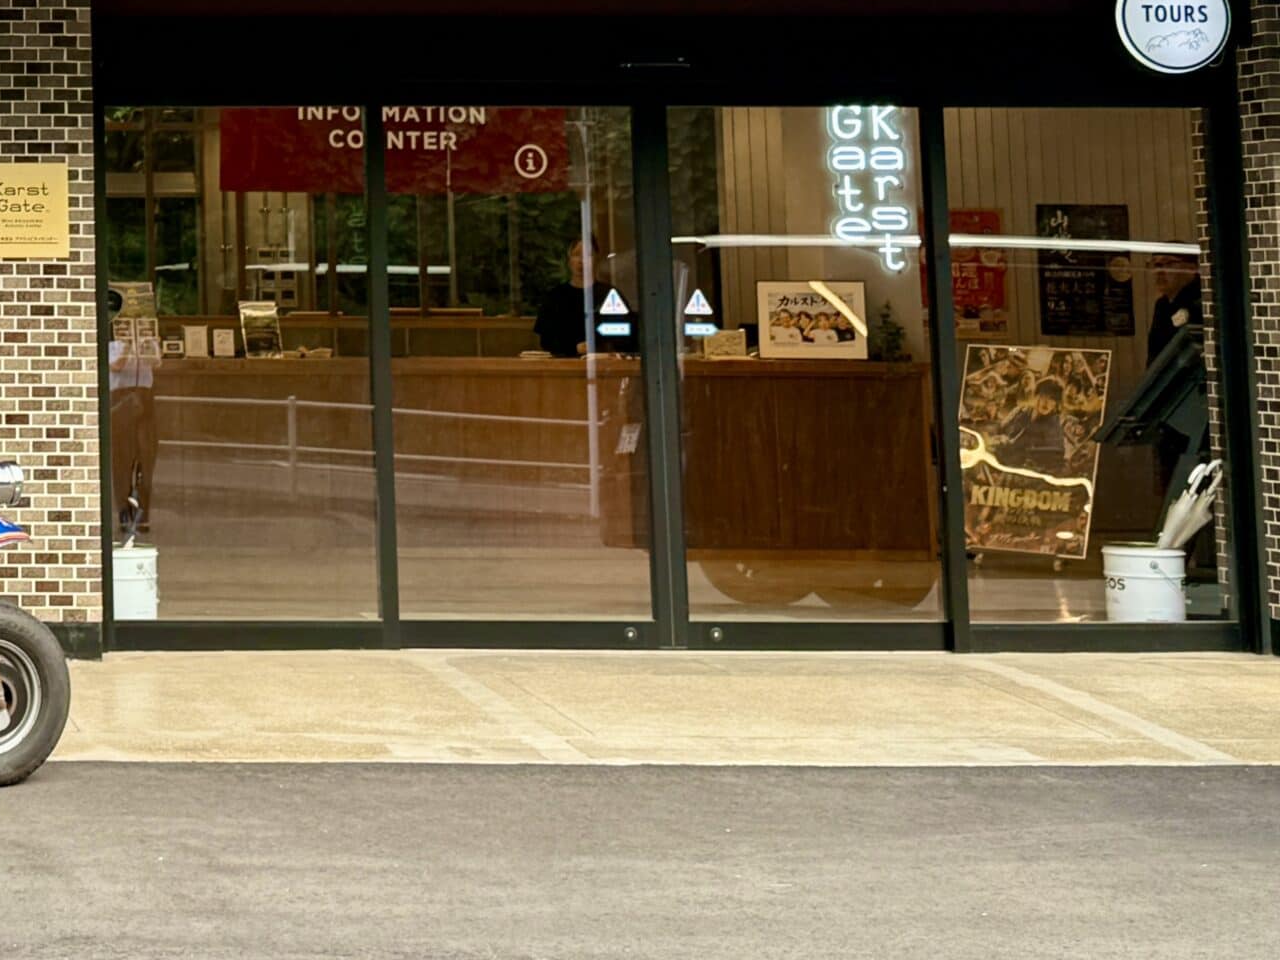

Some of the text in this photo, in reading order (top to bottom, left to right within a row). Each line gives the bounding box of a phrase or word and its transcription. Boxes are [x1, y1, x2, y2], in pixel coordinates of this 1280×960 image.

[1141, 5, 1208, 23] TOURS
[296, 106, 487, 125] INFOMATION
[328, 129, 458, 151] CONTER
[831, 105, 872, 241] Gate
[870, 105, 909, 271] Karst
[971, 485, 1072, 512] KINGDOM
